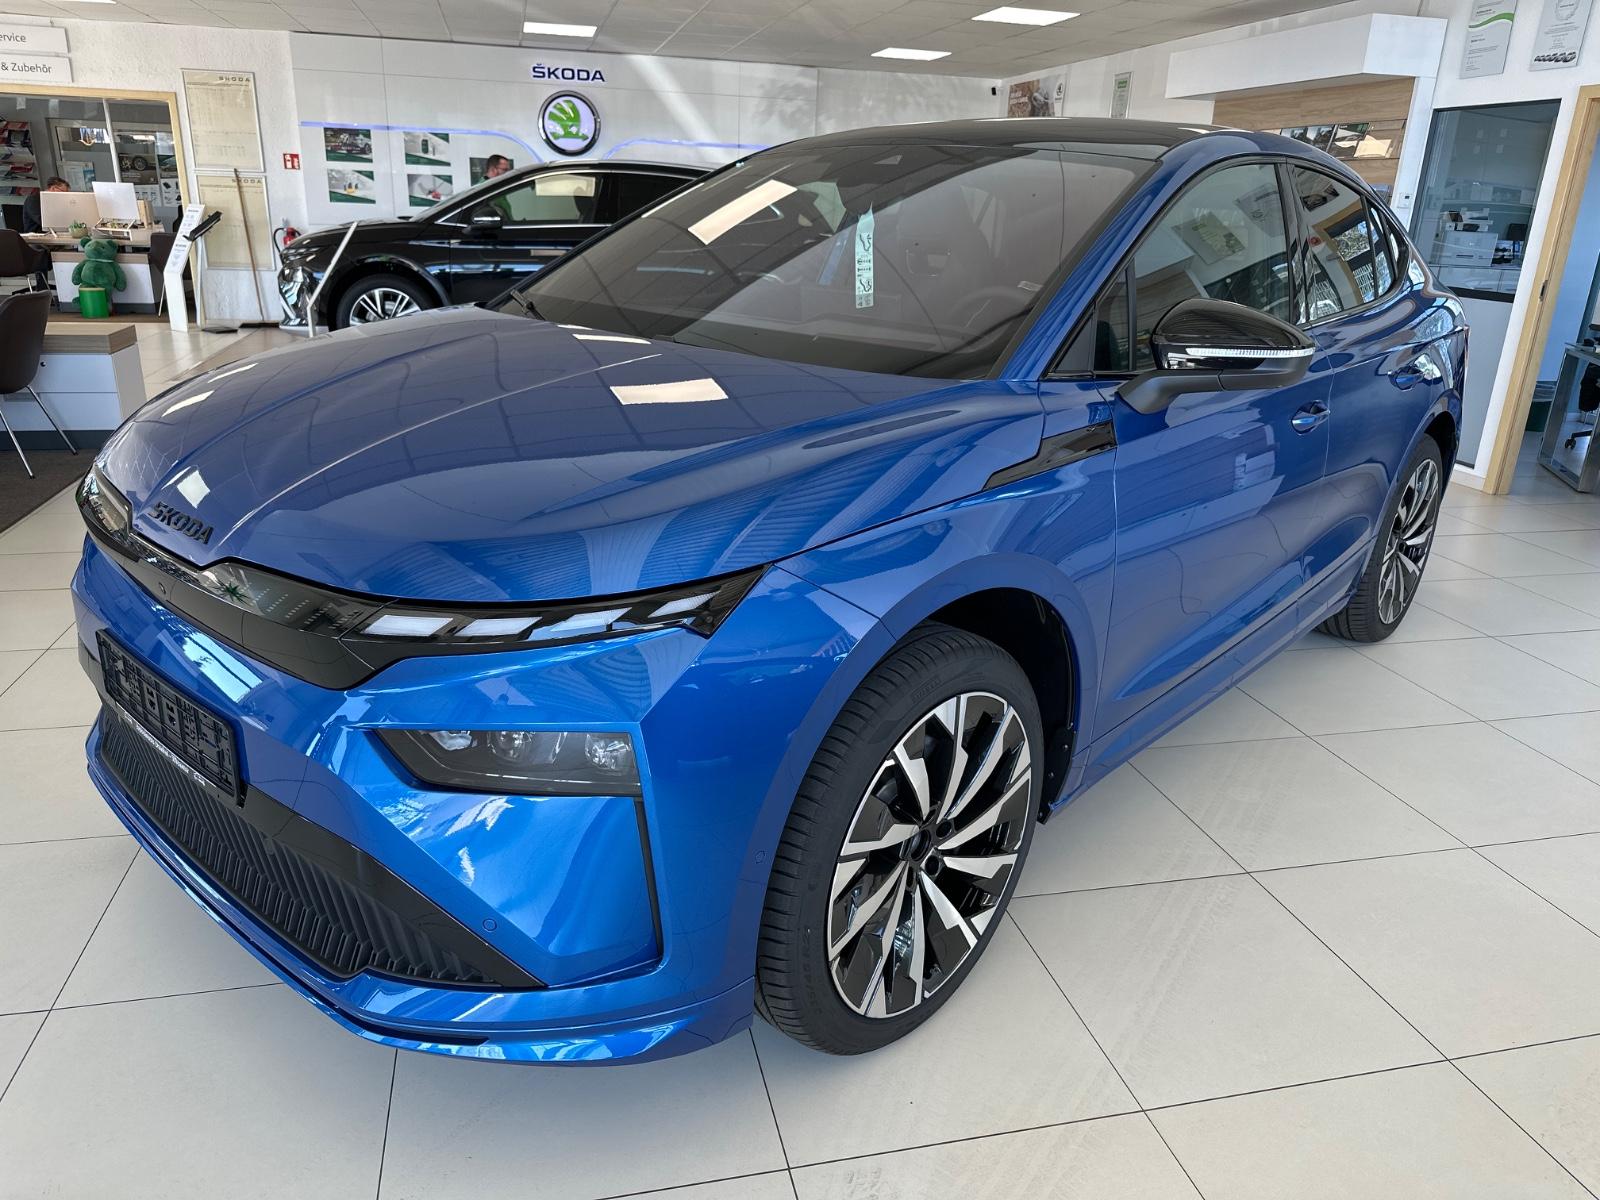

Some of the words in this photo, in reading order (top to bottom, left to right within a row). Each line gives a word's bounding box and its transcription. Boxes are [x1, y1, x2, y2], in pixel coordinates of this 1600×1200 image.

[1, 62, 9, 71] &
[11, 62, 52, 73] Zubehör
[532, 63, 606, 82] ŠKODA
